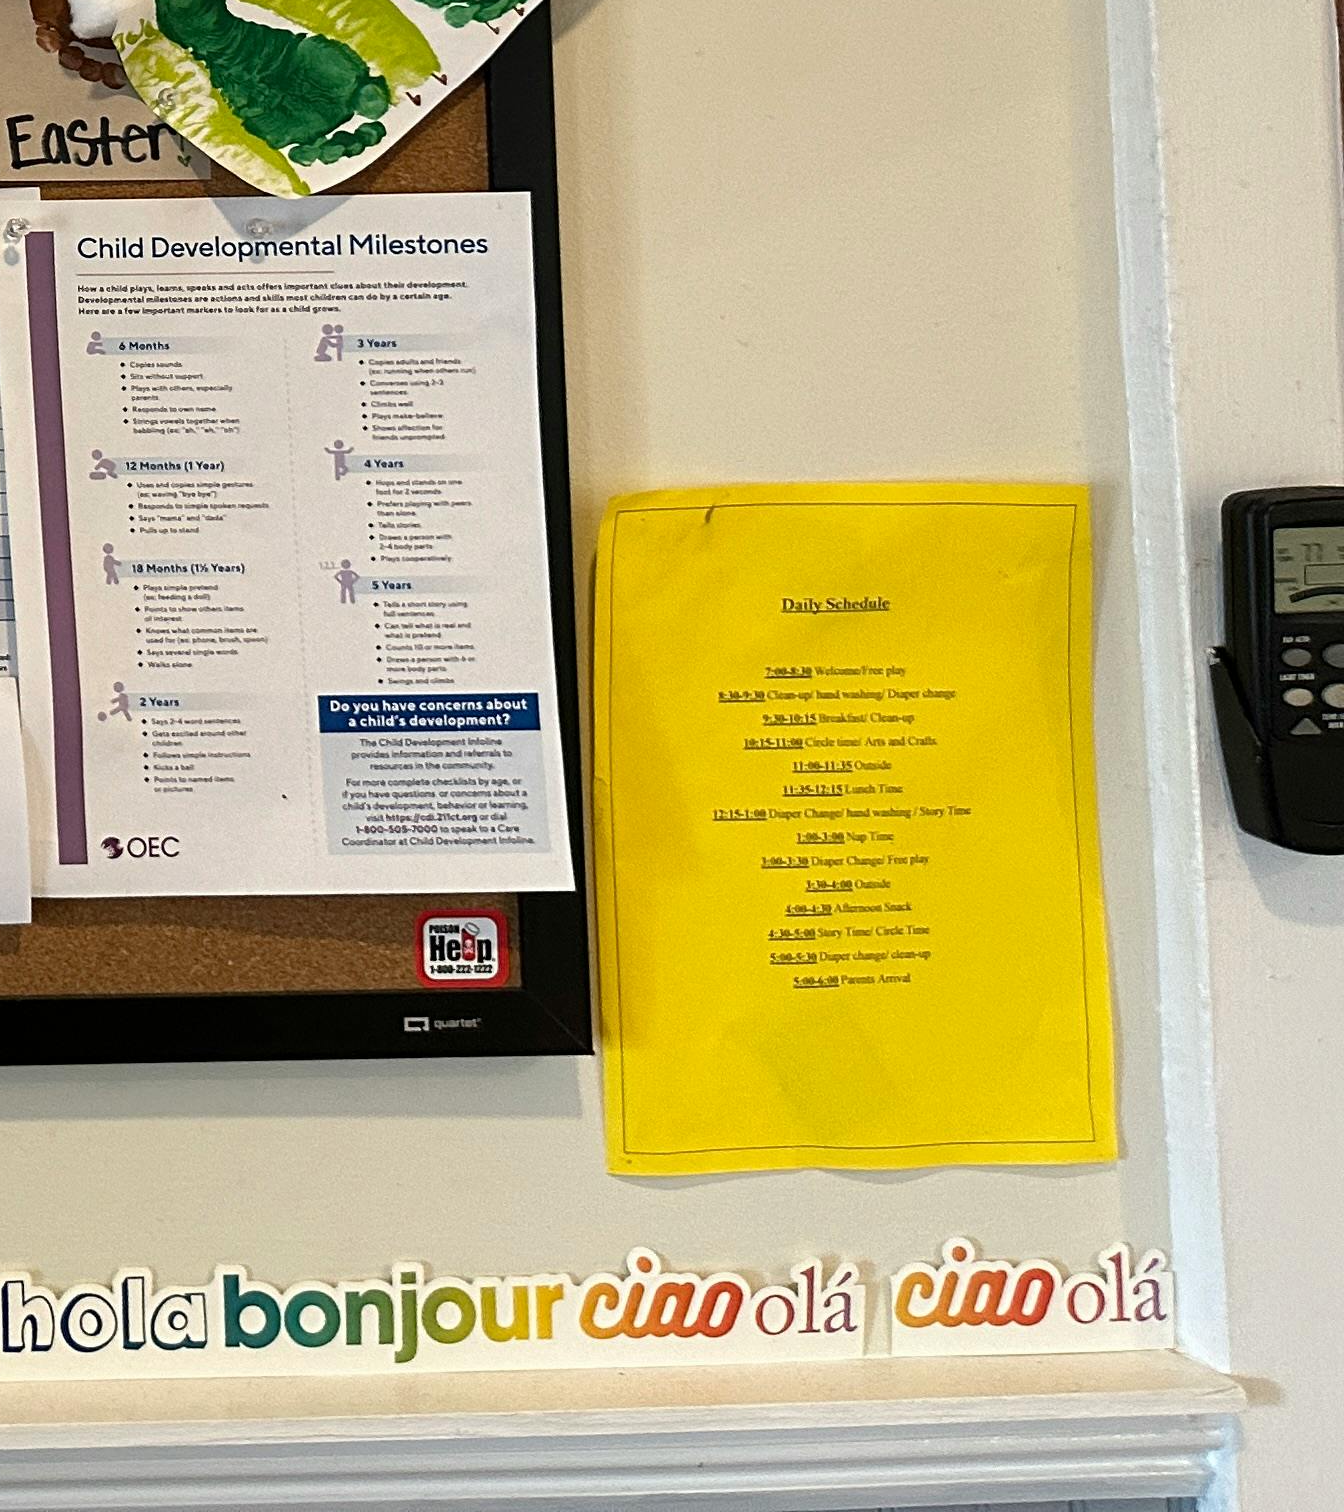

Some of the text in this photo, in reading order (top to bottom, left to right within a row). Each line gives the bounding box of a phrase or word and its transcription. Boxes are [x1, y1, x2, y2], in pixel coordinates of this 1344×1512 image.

[77, 233, 489, 261] Child Developmental Milestones
[118, 341, 170, 351] 6 Months
[357, 338, 398, 349] 3 Years
[125, 460, 225, 473] 12 Months (1 Year)
[363, 459, 405, 469] 4 Years
[131, 563, 144, 574] 18
[146, 563, 188, 574] Months
[210, 562, 246, 575] Years)
[371, 580, 412, 591] 5 Years
[781, 597, 891, 615] Daily Schedule
[139, 696, 180, 707] 2 Years
[329, 697, 528, 715] Do you have concerns about
[348, 713, 511, 729] a child's development?
[844, 783, 904, 795] Lunch Time
[126, 836, 180, 859] OEC
[429, 934, 492, 963] Help
[894, 1243, 1168, 1328] ciao olá
[1, 1280, 207, 1349] hola
[224, 1275, 564, 1363] bonjour
[578, 1253, 745, 1337] ciao
[754, 1270, 860, 1337] olá
